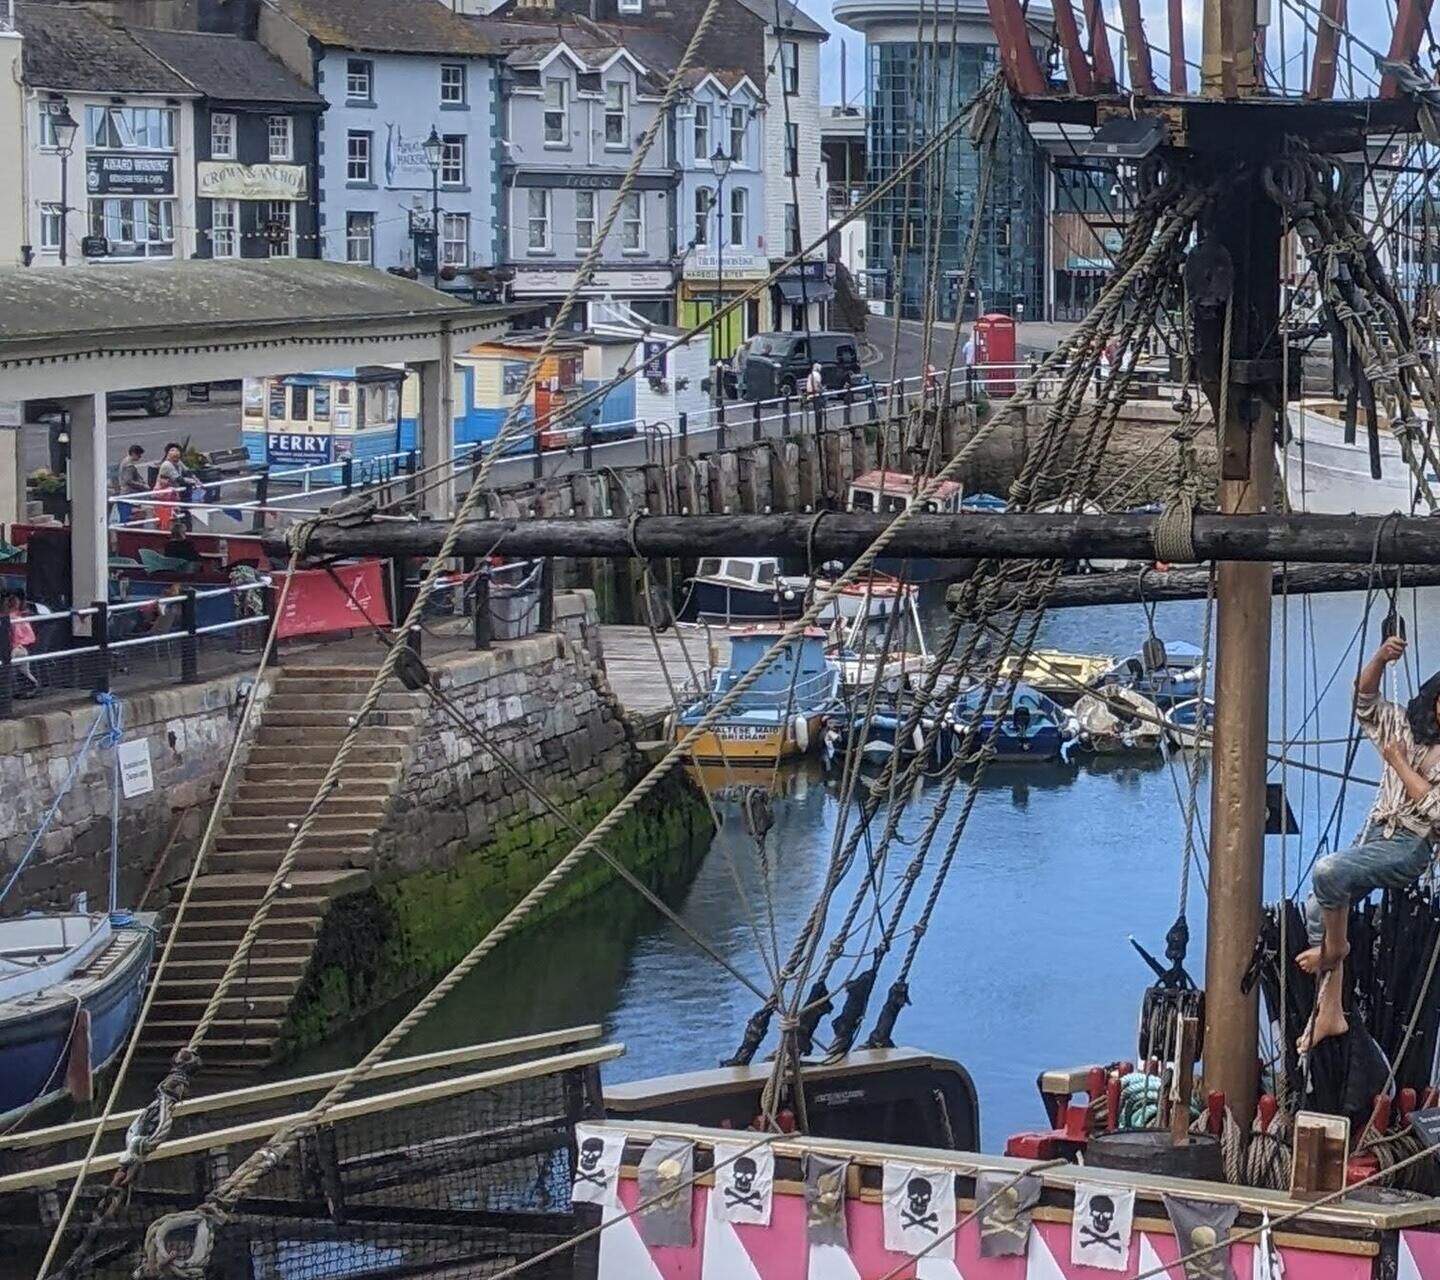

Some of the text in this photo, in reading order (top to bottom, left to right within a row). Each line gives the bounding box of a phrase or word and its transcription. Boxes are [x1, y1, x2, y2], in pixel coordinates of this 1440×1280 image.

[103, 158, 169, 172] AWARD WINNING
[202, 167, 245, 187] CROWN
[268, 434, 328, 452] FERRY
[708, 726, 750, 735] ALTESE
